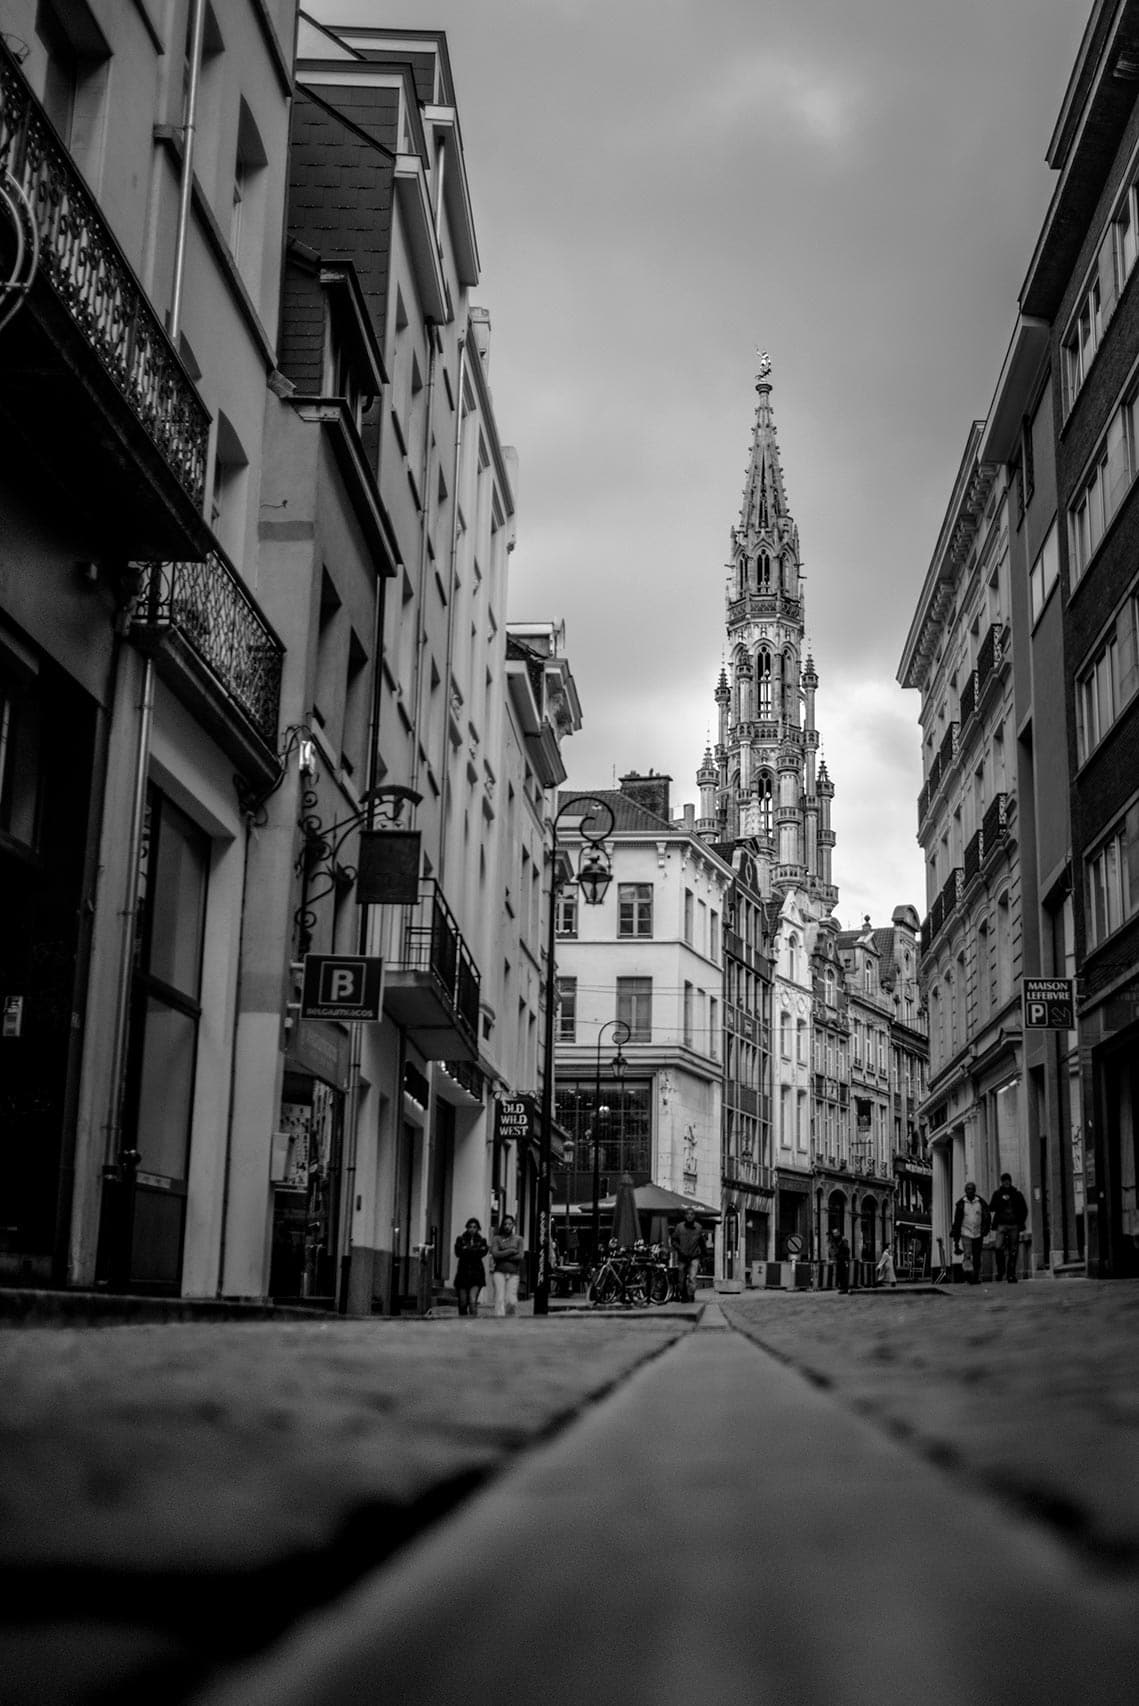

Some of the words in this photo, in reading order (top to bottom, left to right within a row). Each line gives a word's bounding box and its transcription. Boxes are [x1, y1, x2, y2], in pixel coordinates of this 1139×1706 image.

[1028, 981, 1068, 990] MAISON
[1026, 991, 1071, 1000] LEFEBVRE
[1031, 1004, 1044, 1023] P
[503, 1103, 524, 1114] OLD
[500, 1114, 527, 1124] WILD
[499, 1125, 528, 1135] WEST
